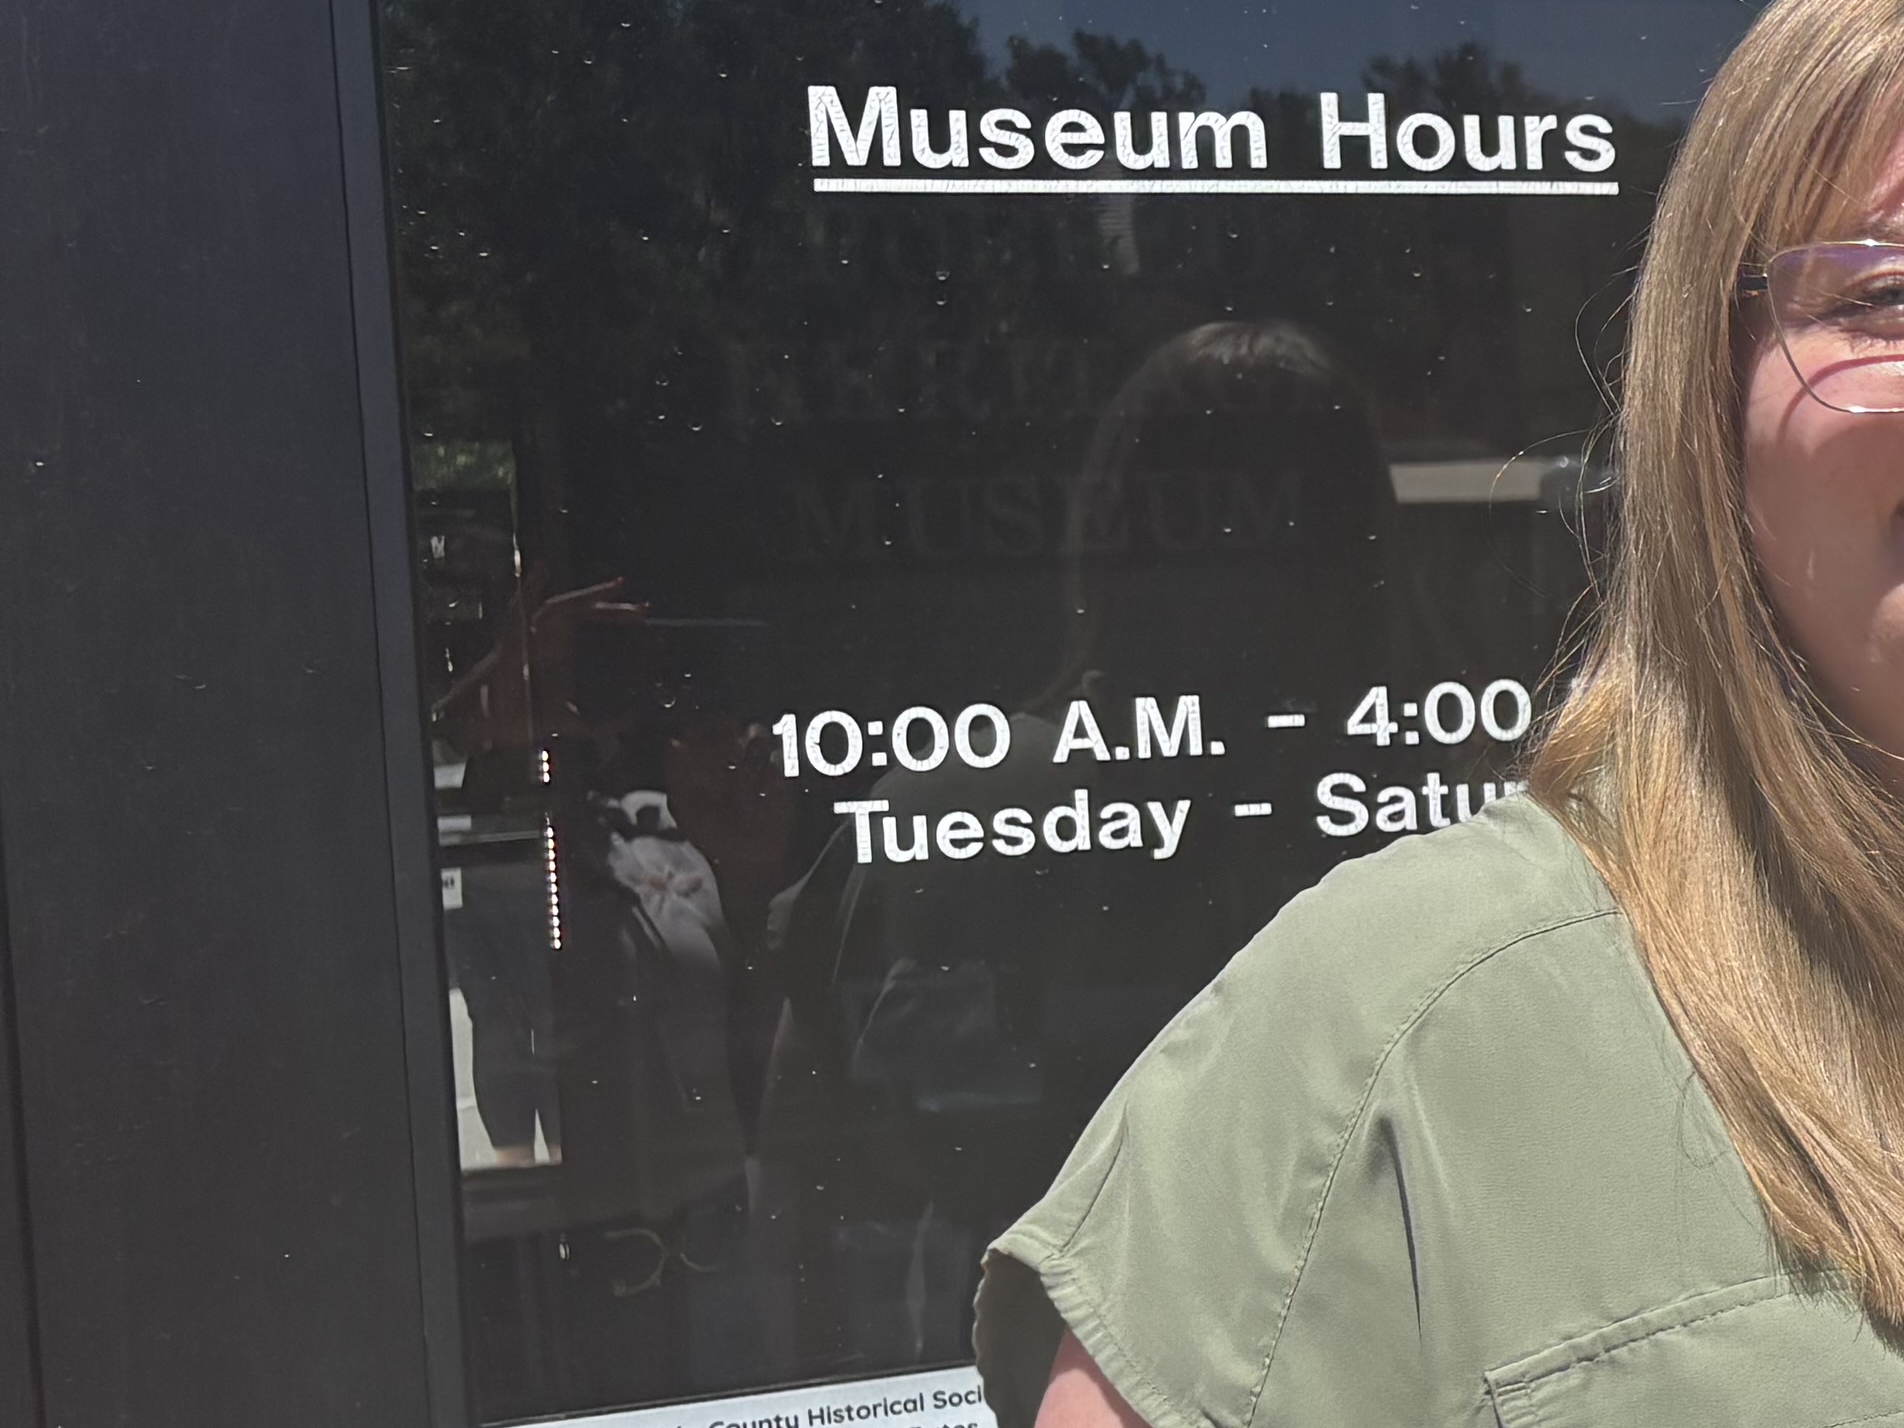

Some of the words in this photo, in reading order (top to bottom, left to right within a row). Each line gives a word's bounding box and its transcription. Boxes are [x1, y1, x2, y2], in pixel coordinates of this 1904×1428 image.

[807, 85, 1268, 170] Museum
[1319, 91, 1616, 173] Hours
[772, 703, 1011, 778] 10:00
[1052, 694, 1226, 763] A.M.
[1346, 679, 1532, 747] 4:00
[833, 788, 1191, 864] Tuesday
[808, 1392, 924, 1426] Historical
[932, 1385, 982, 1410] Soci
